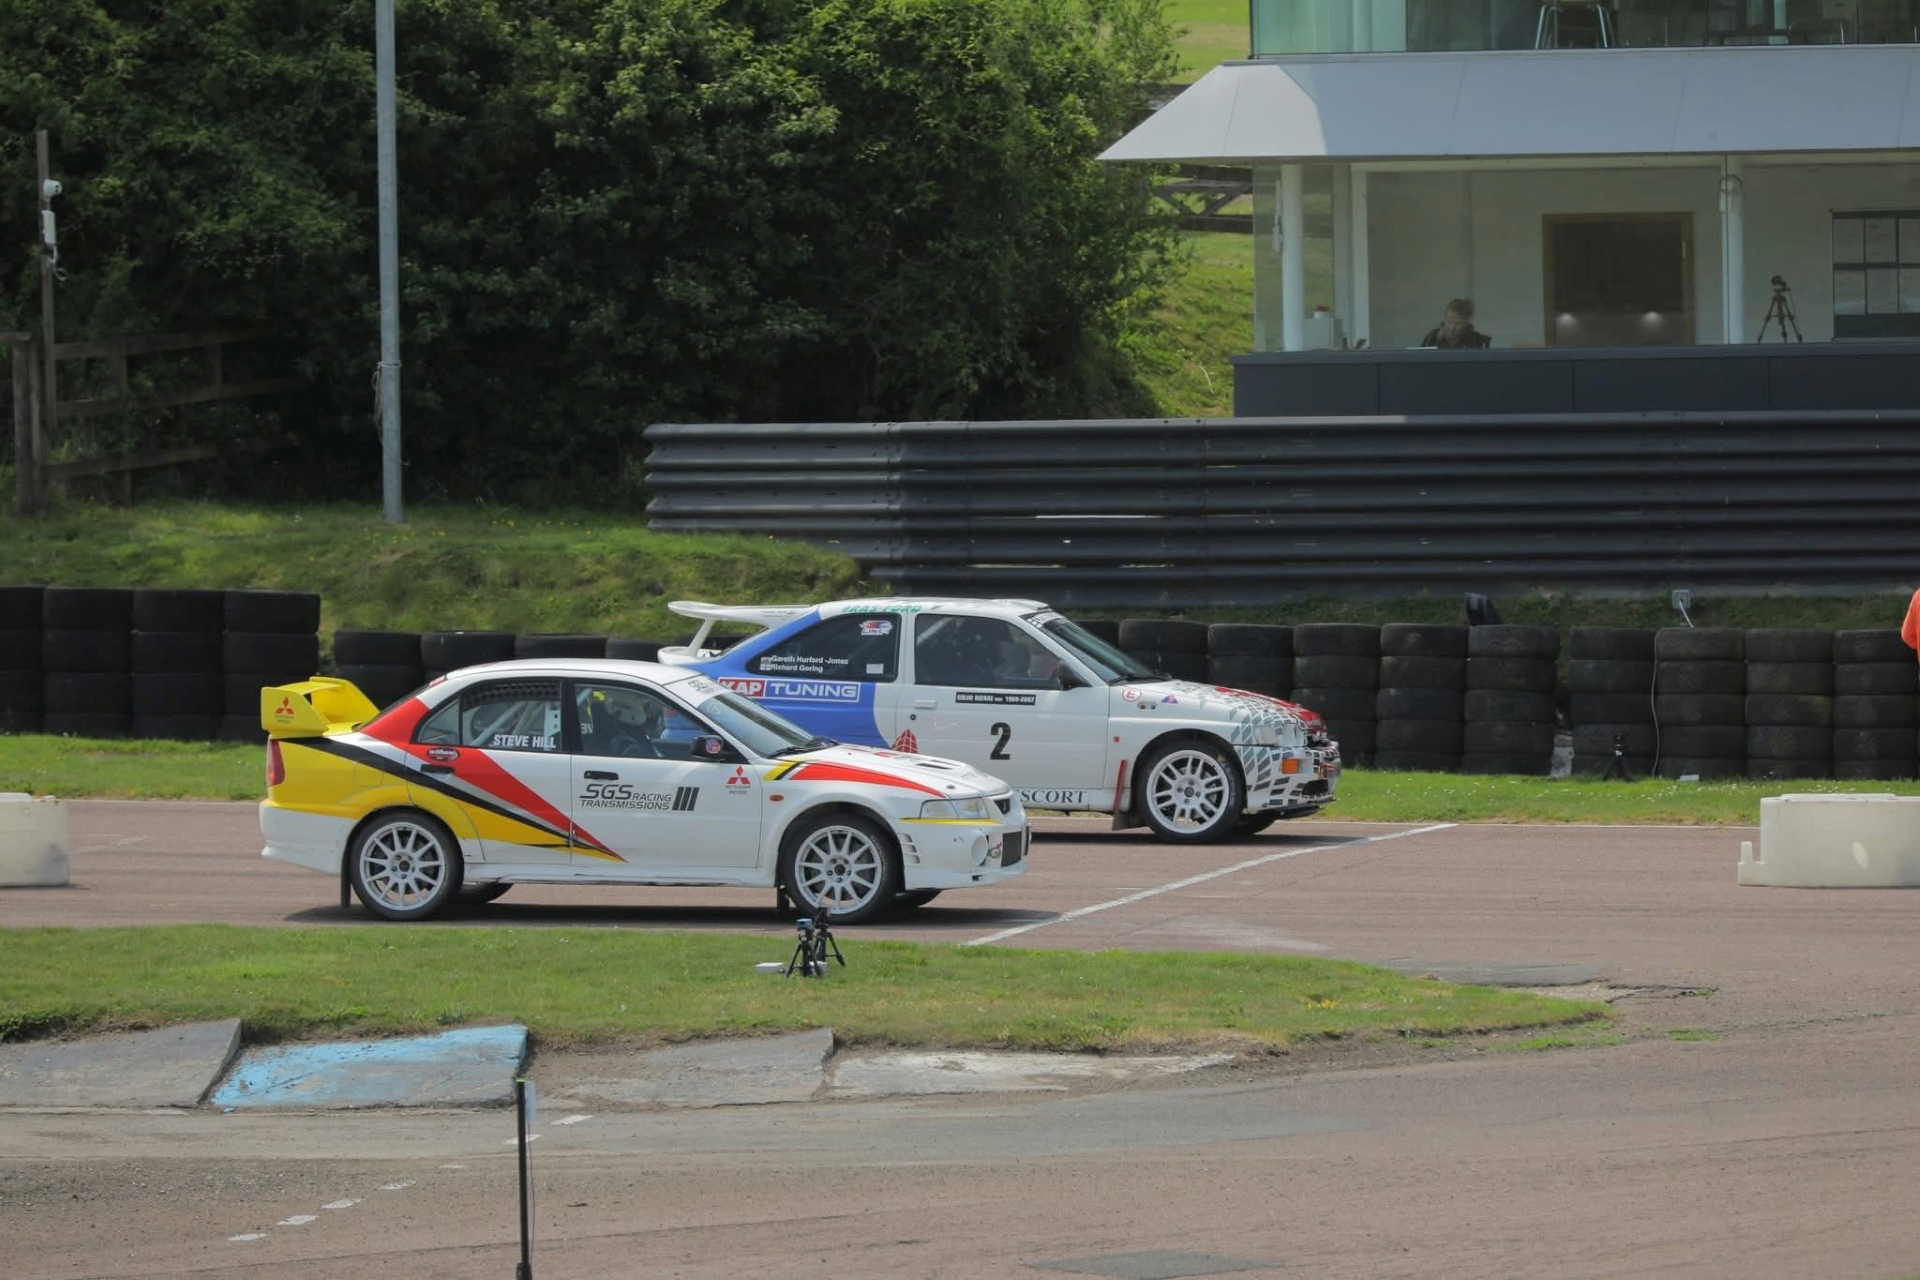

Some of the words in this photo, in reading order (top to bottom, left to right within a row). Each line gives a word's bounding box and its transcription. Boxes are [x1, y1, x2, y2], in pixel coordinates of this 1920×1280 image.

[771, 655, 795, 663] Gareth
[797, 656, 824, 664] Hurford
[799, 665, 824, 673] Goring
[770, 683, 857, 698] TUNING
[493, 734, 529, 747] STEVE
[532, 735, 556, 749] HILL
[990, 722, 1011, 760] 2
[579, 783, 634, 800] SGS
[632, 792, 673, 802] RACING
[1014, 789, 1087, 804] SCORT
[580, 799, 670, 811] TRANSMISSIONS
